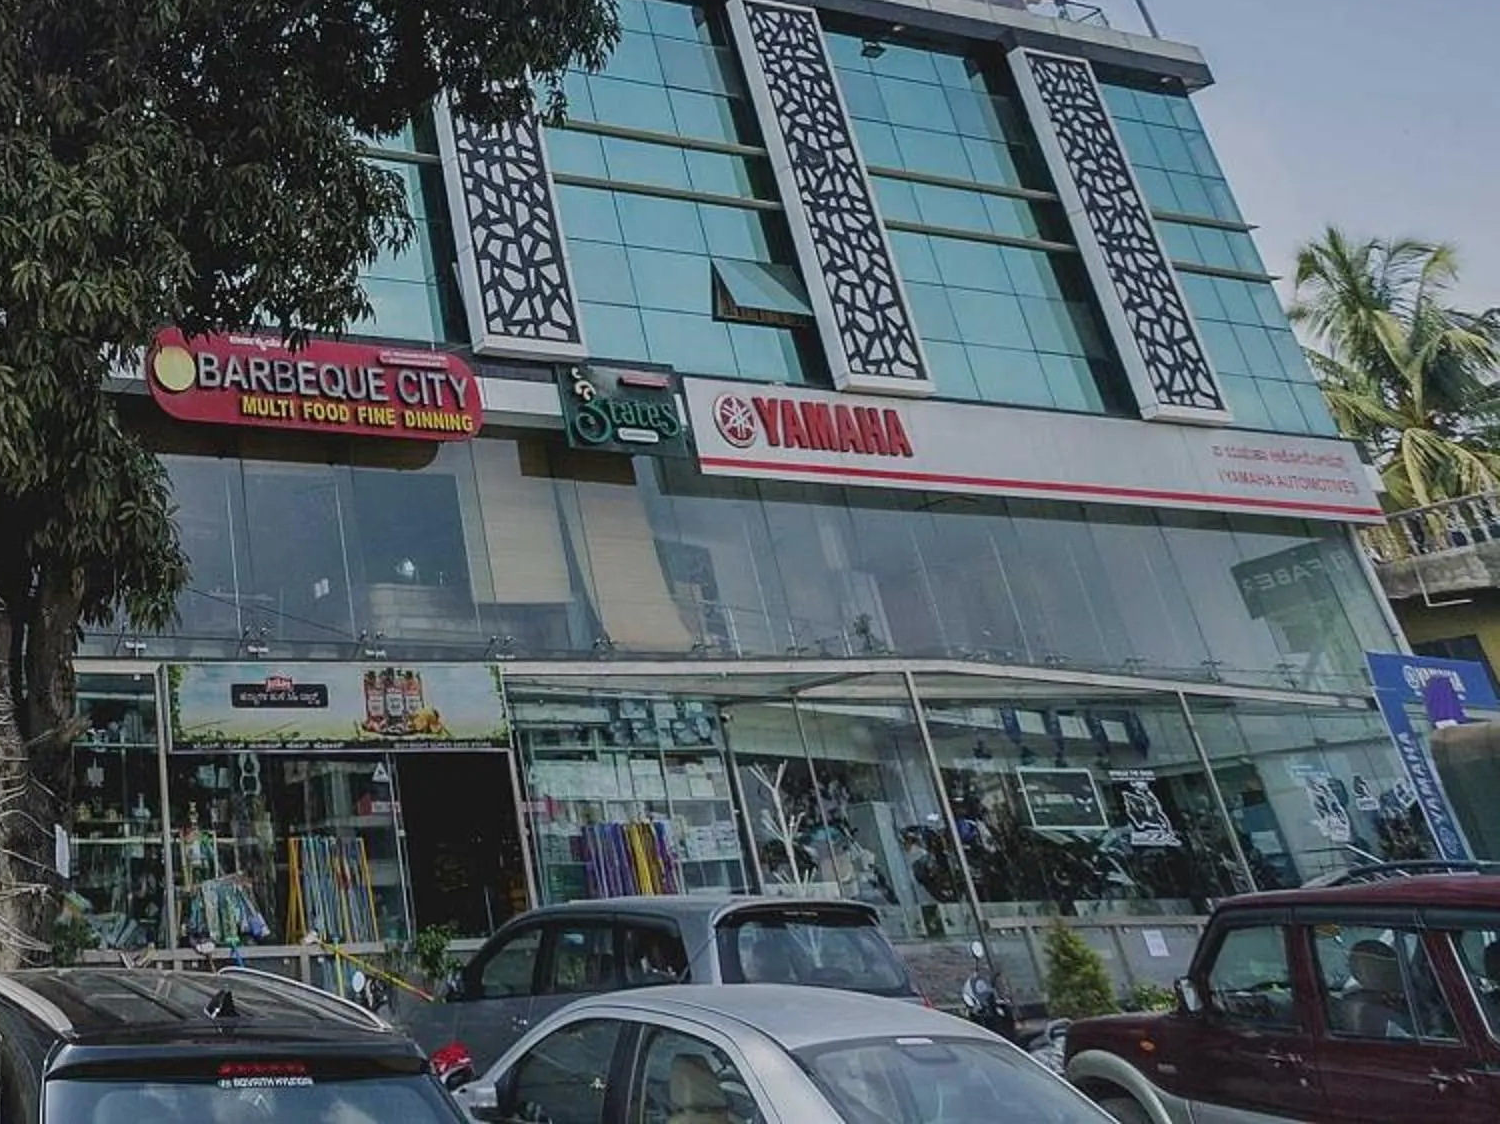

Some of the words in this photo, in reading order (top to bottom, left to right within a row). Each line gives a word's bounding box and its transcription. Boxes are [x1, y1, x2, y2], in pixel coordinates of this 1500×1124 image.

[197, 351, 389, 403] BARBEQUE
[397, 369, 470, 410] CITY
[241, 395, 296, 418] MULTI
[303, 403, 350, 423] FOOD
[357, 406, 396, 426] FINE
[404, 411, 474, 432] DINNING
[576, 398, 680, 443] States
[751, 396, 914, 457] YAMAHA
